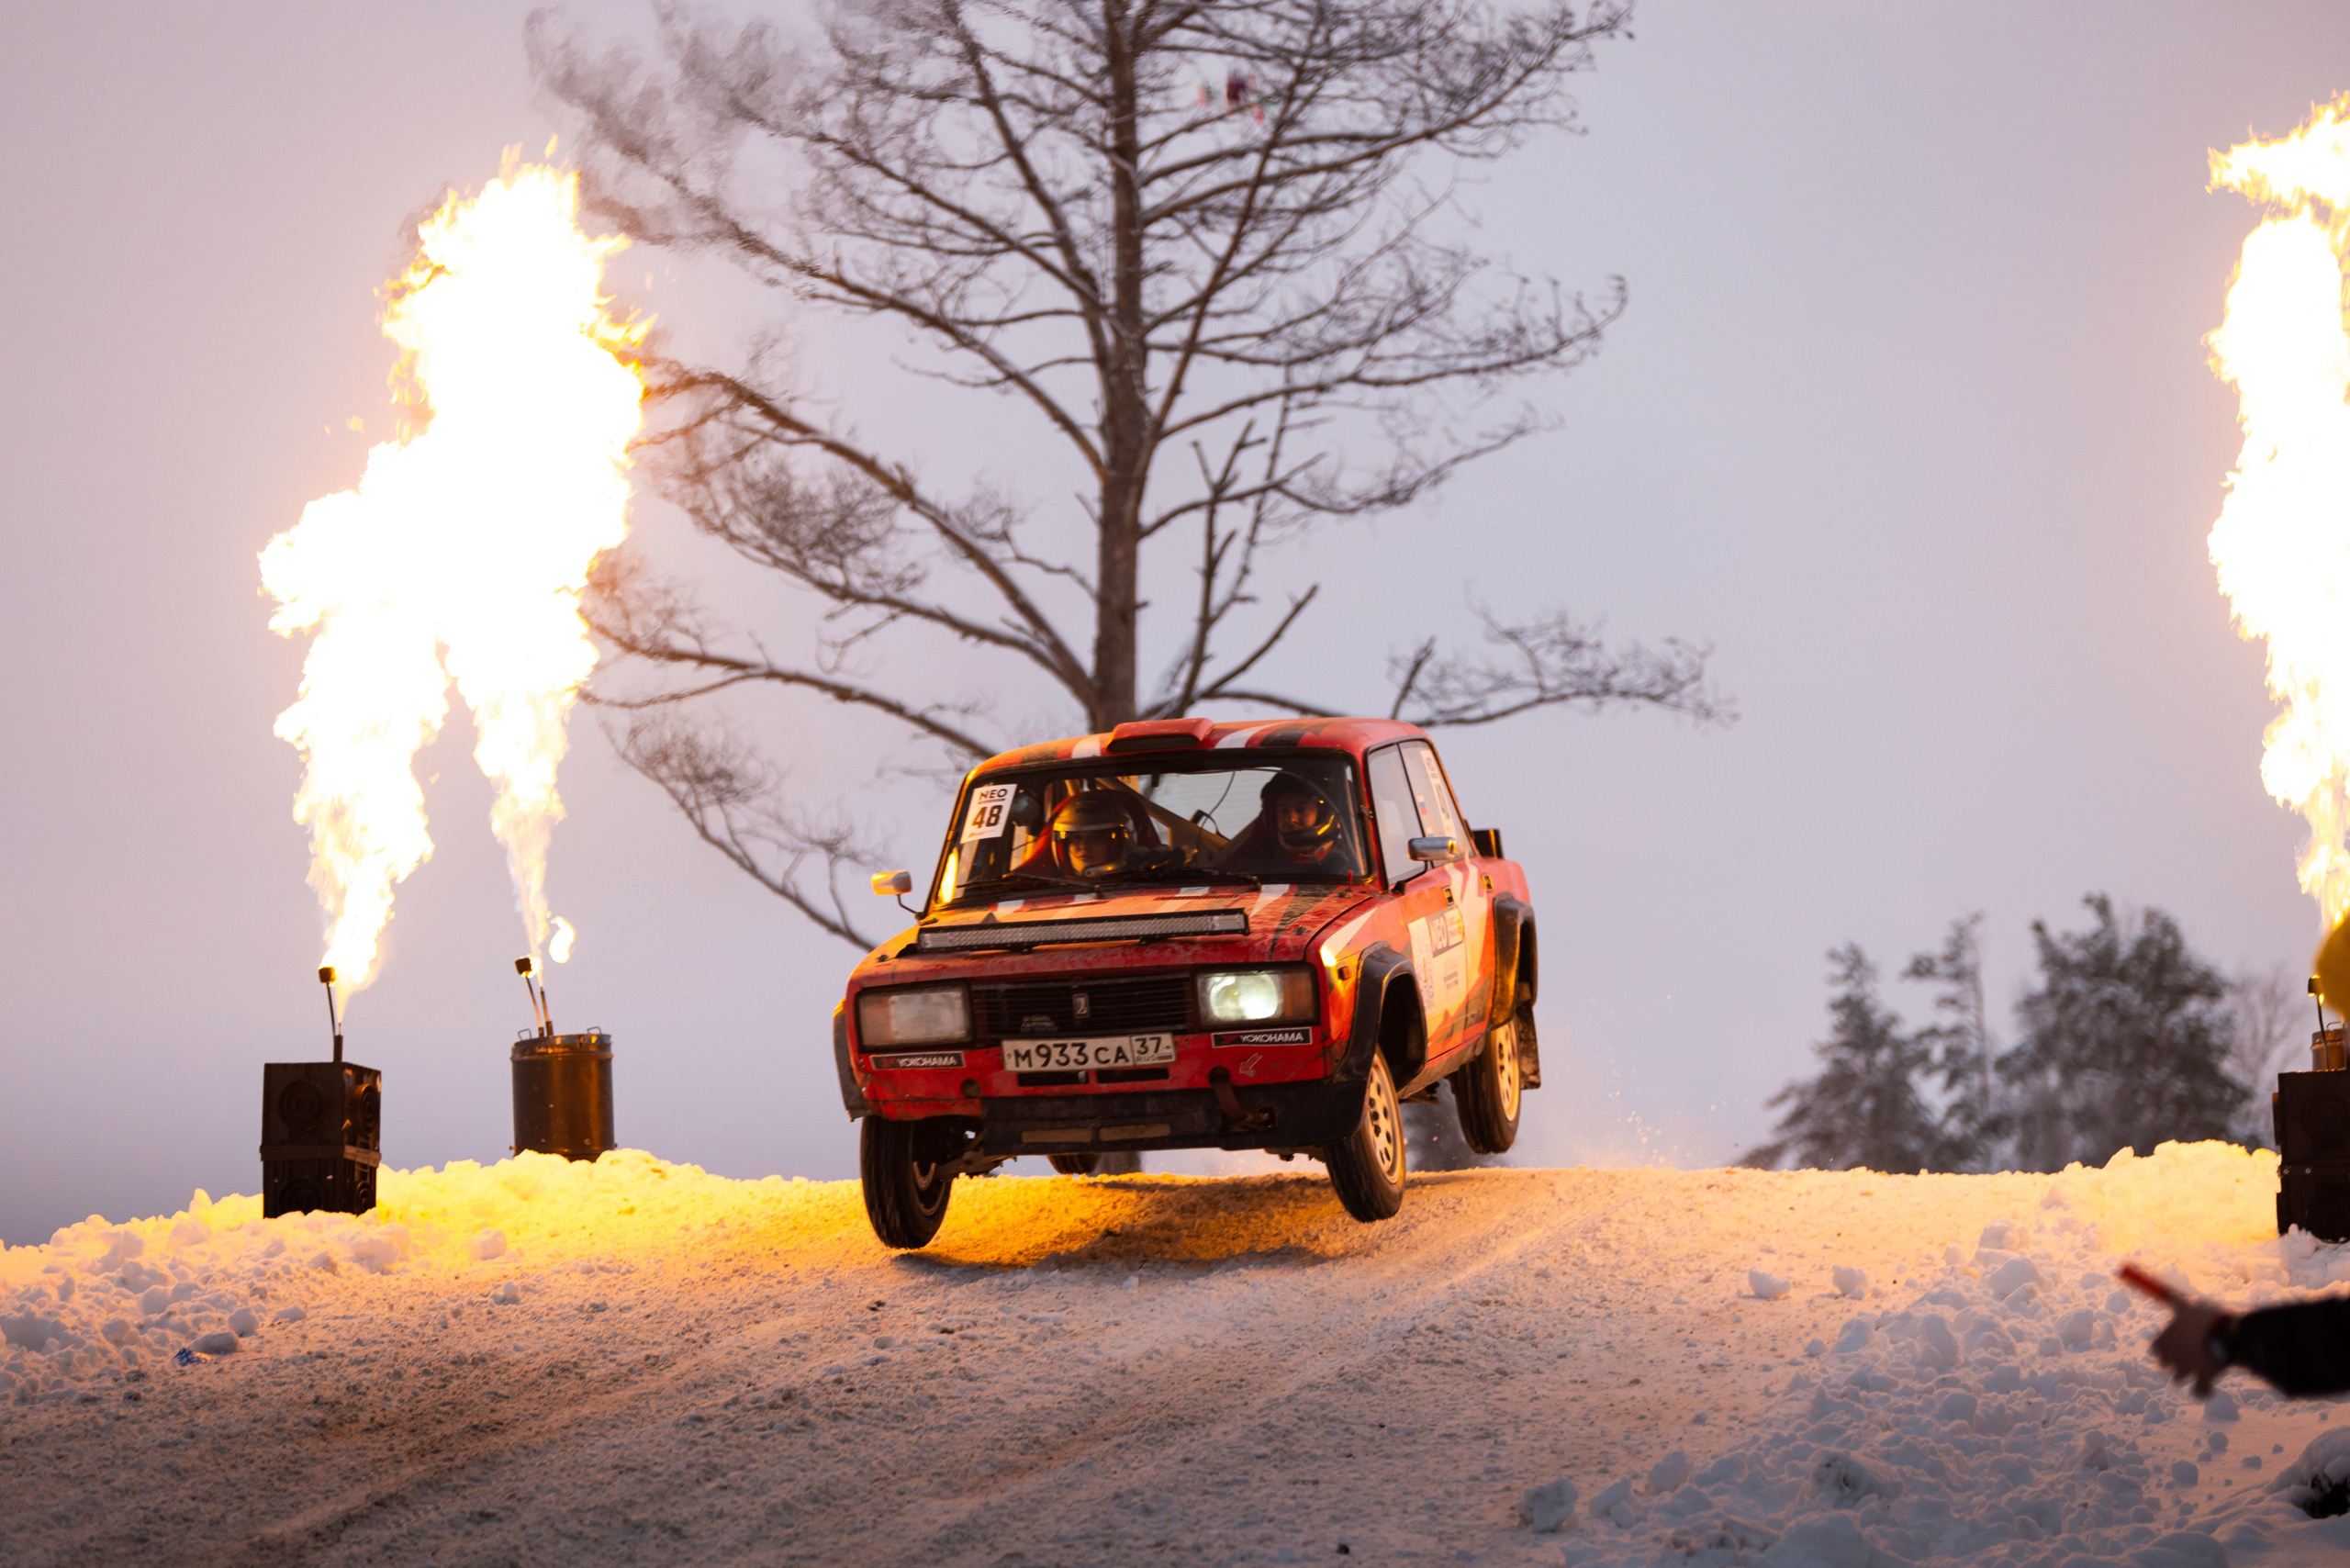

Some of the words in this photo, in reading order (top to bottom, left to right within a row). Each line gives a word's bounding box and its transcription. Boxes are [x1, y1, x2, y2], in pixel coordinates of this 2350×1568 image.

[979, 789, 1008, 800] NEO
[971, 805, 1002, 828] 48
[1240, 1032, 1304, 1043] YOKOHAMA
[1136, 1036, 1161, 1055] 37
[896, 1056, 957, 1068] YOKOHAMA
